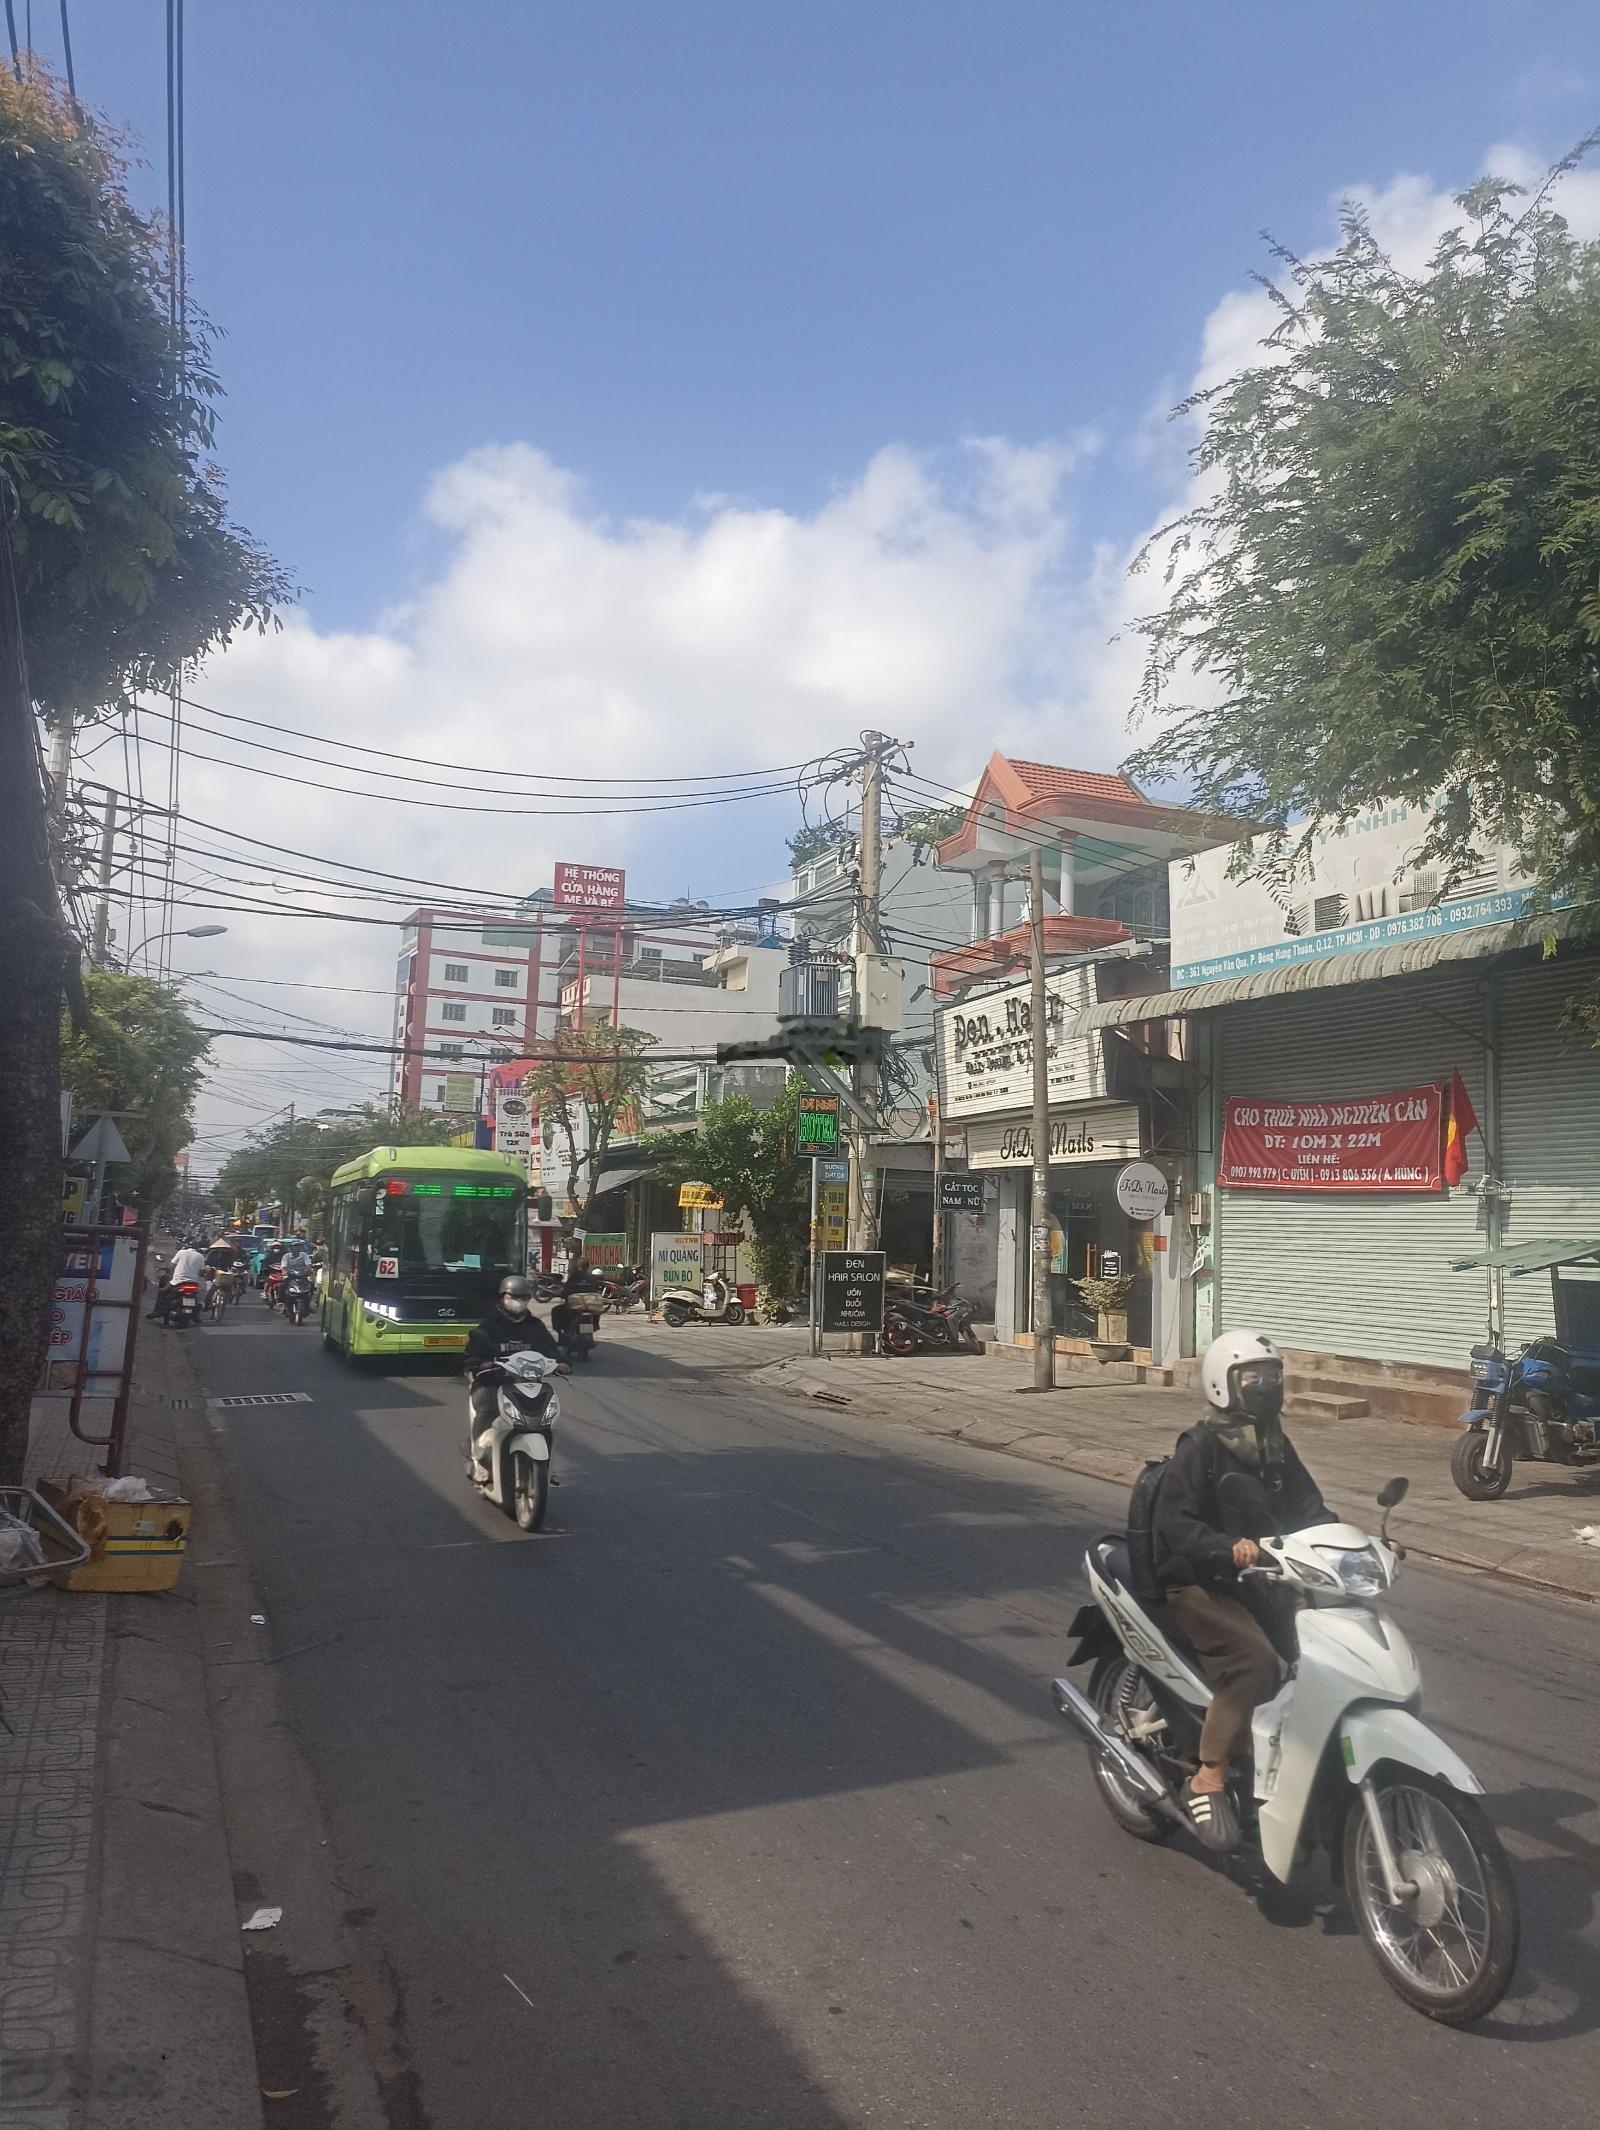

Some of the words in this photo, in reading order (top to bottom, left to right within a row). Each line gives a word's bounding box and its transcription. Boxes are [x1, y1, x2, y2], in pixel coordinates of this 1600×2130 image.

[1343, 805, 1408, 839] TNHH
[564, 866, 580, 881] HỆ
[581, 868, 620, 883] THỐNG
[561, 880, 584, 894] CỬA
[587, 883, 619, 897] HÀNG
[583, 895, 599, 906] VÀ
[1189, 966, 1200, 978] 361
[1335, 931, 1363, 947] TP.HCM
[1386, 916, 1425, 937] 0976.382
[1426, 911, 1442, 928] 706
[1450, 902, 1492, 923] 0932.764
[1494, 896, 1513, 913] 393
[1003, 992, 1065, 1034] Har
[1234, 1106, 1260, 1126] CHO
[1264, 1105, 1297, 1127] THUÊ
[1297, 1104, 1329, 1127] NHÀ
[1330, 1100, 1392, 1126] NGUYÊN
[514, 1130, 530, 1138] Sữa
[799, 1112, 836, 1143] HOTEL
[1048, 1120, 1094, 1156] Nails
[1264, 1133, 1286, 1149] DT:
[1291, 1134, 1327, 1149] 10M
[1330, 1134, 1342, 1149] X
[1346, 1132, 1382, 1148] 22M
[1297, 1152, 1321, 1165] LIÊN
[1230, 1165, 1247, 1178] 0907
[1290, 1165, 1310, 1181] UYÊN
[1319, 1168, 1341, 1181] 0913
[1342, 1168, 1360, 1181] 806
[1394, 1164, 1422, 1181] HÙNG
[1144, 1180, 1169, 1196] Nails
[942, 1196, 962, 1205] NAM
[967, 1196, 981, 1206] NỮ
[669, 1245, 699, 1264] QUẢNG
[379, 1260, 396, 1275] 62
[845, 1259, 865, 1269] ĐEN
[828, 1272, 849, 1282] HAIR
[850, 1272, 881, 1282] SALON
